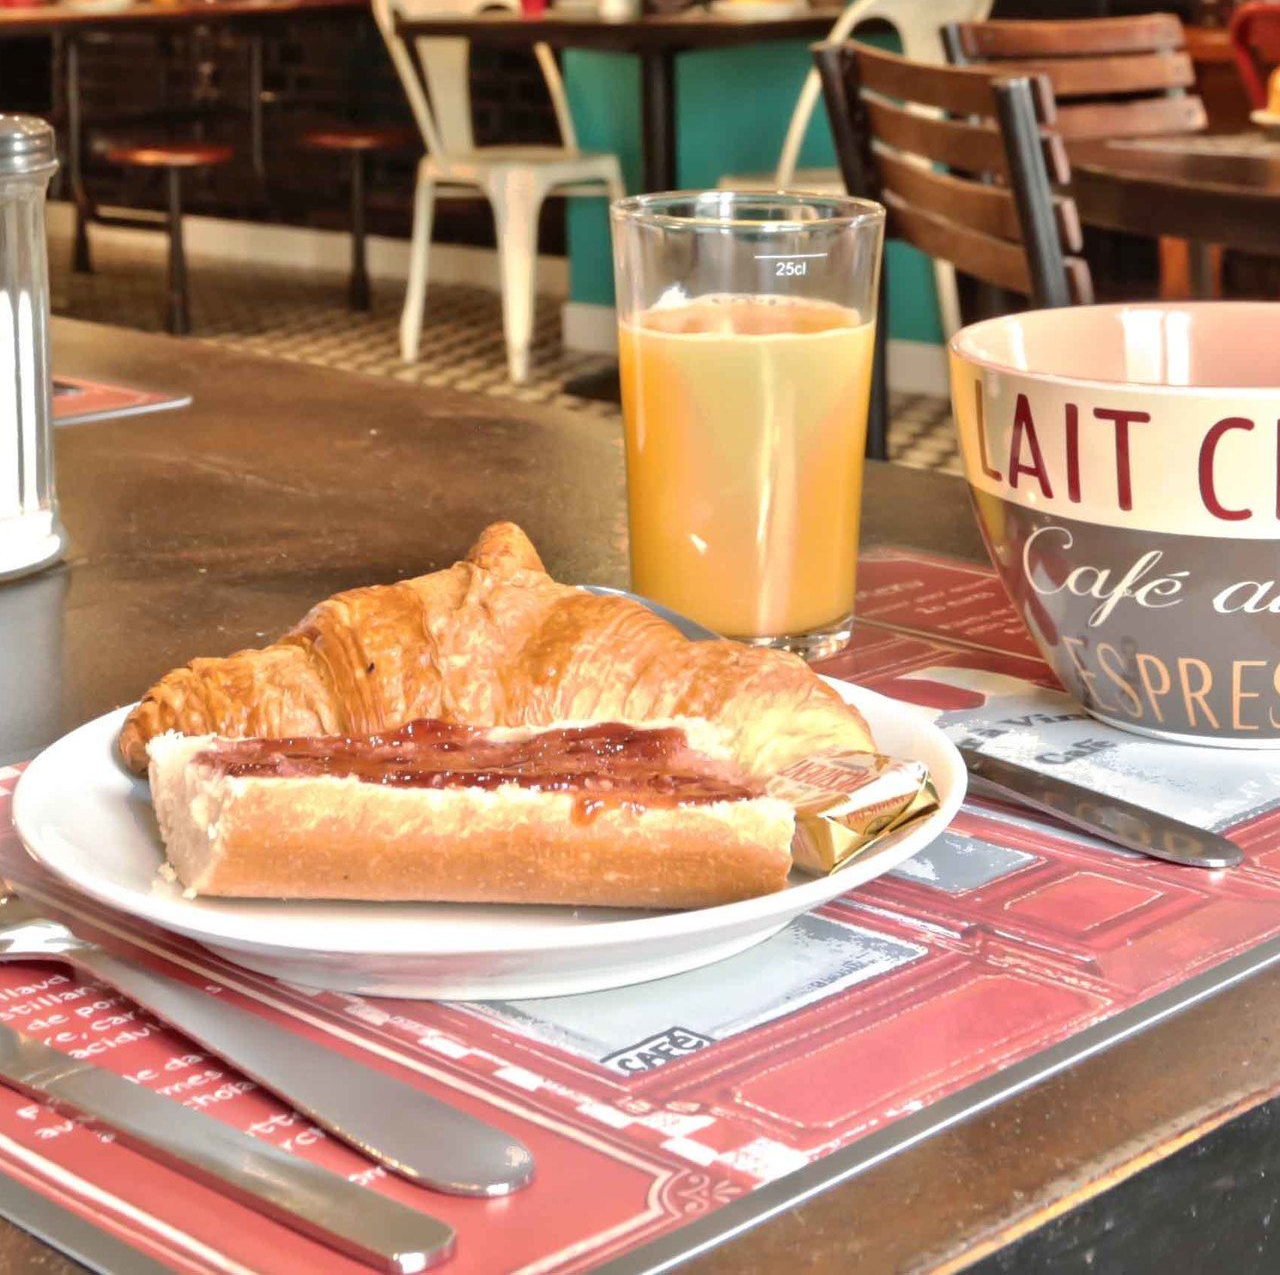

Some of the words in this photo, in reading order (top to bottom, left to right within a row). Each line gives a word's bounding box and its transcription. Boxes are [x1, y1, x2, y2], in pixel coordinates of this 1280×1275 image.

[775, 260, 807, 277] 25cl
[974, 378, 1152, 512] LAIT
[1022, 525, 1191, 628] Café
